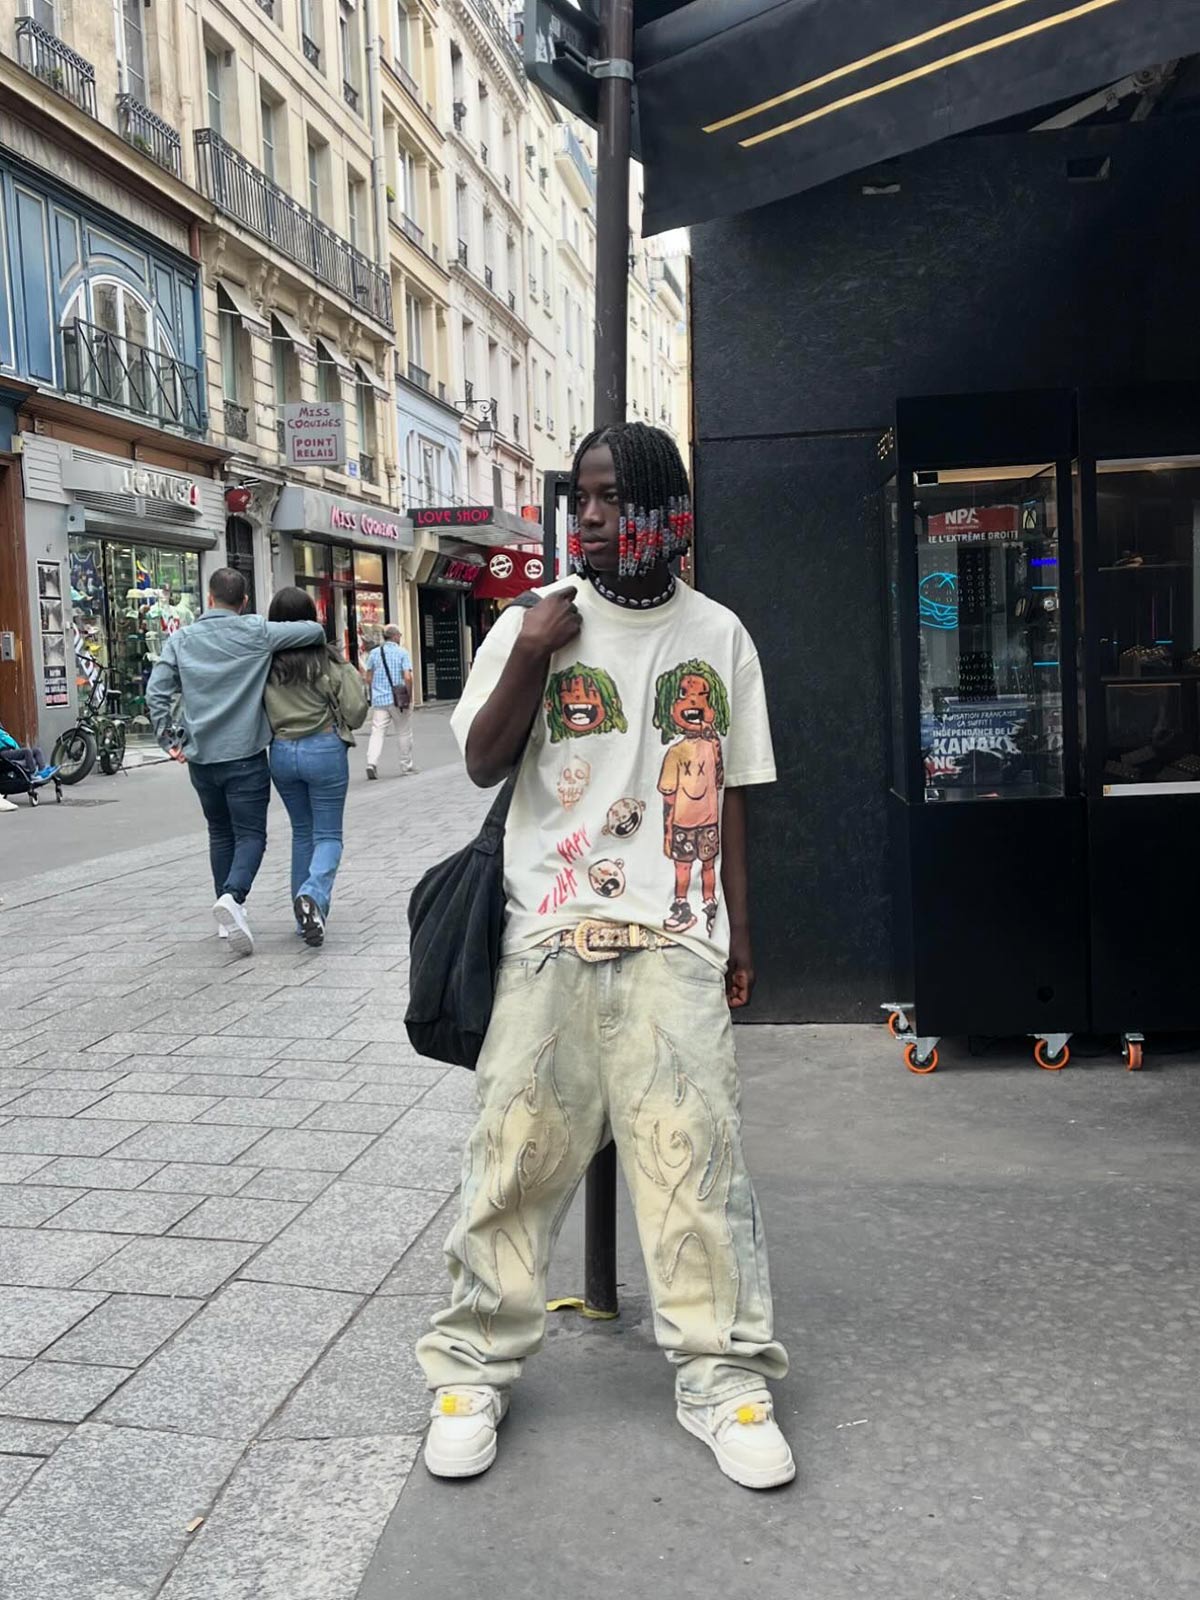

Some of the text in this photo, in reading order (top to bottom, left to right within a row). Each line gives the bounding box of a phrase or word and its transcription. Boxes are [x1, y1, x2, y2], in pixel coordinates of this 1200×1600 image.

[287, 418, 342, 429] COQUINES
[296, 438, 332, 447] POINT
[296, 449, 334, 458] RELAIS
[417, 509, 489, 525] LOVE SHOP
[944, 507, 980, 525] NPA
[994, 728, 1005, 736] DE
